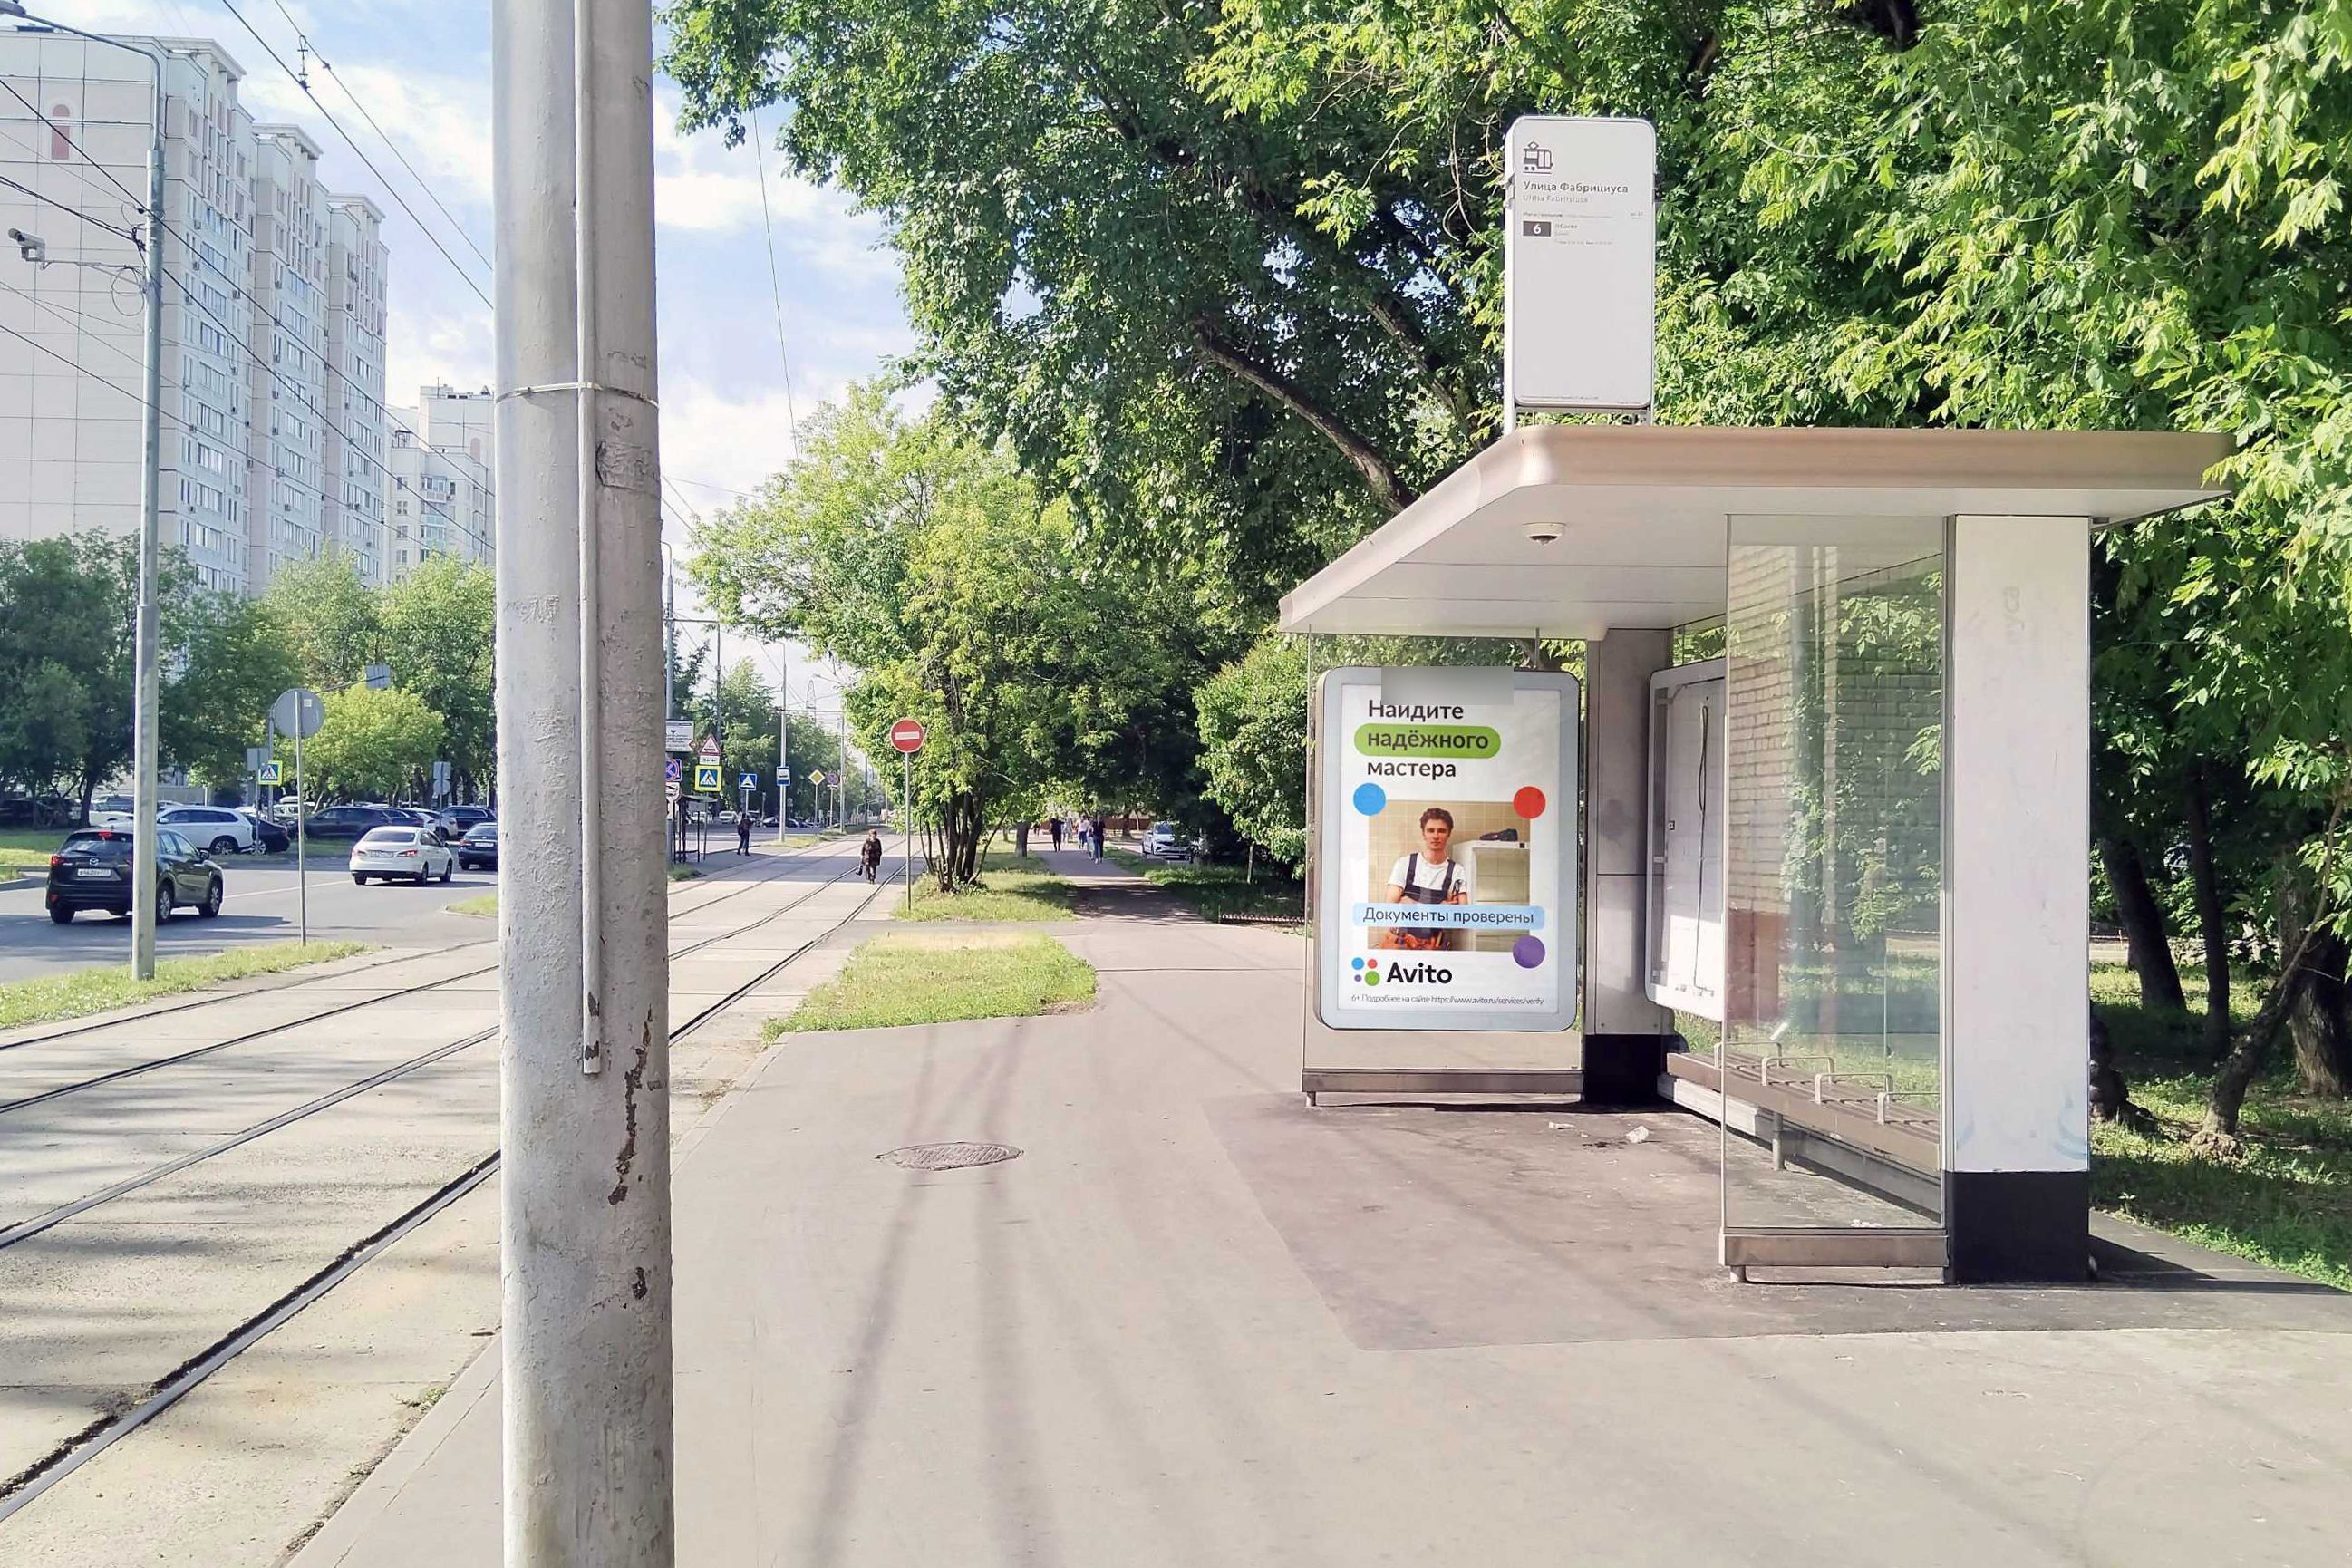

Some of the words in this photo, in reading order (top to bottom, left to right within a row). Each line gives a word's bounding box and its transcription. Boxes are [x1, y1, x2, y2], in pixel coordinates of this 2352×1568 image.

[1523, 180, 1557, 192] Улица
[1560, 181, 1629, 195] Фабрициуса
[1533, 223, 1542, 235] 6
[1368, 730, 1489, 750] надёжного
[1367, 762, 1457, 780] мастера
[1362, 907, 1449, 923] Документы
[1453, 911, 1534, 925] проверены
[1386, 962, 1453, 984] Avito
[1361, 994, 1400, 1003] Подробнее
